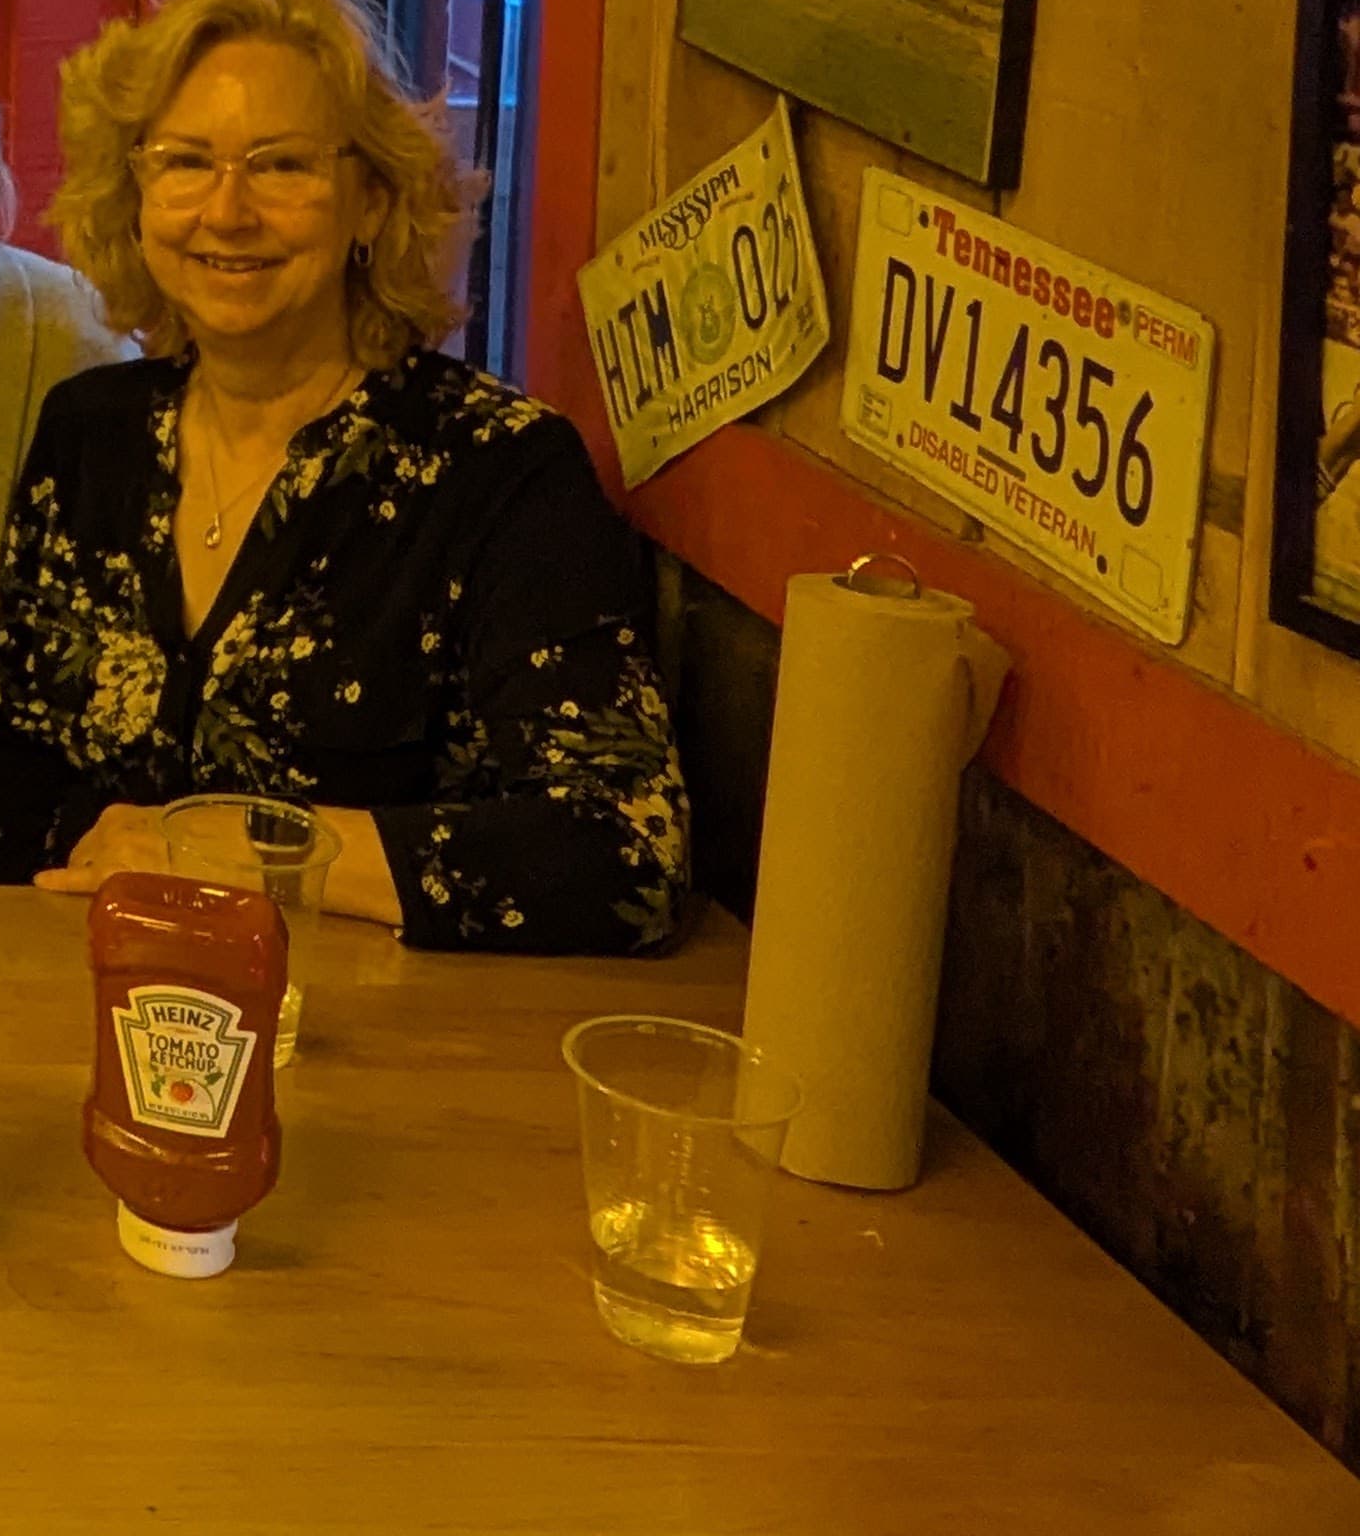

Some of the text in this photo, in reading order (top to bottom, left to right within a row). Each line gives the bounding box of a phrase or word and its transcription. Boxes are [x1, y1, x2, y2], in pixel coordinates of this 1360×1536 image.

[638, 165, 740, 254] MISSISSIPPI
[932, 205, 1198, 363] Tennessee PERM
[666, 344, 774, 433] HARRISON
[877, 256, 1154, 527] DV14356
[909, 420, 1097, 559] DISABLED VETERAN
[145, 1031, 220, 1061] TOMATO
[150, 1050, 217, 1074] KETCHUP
[151, 1005, 216, 1032] HEINZ
